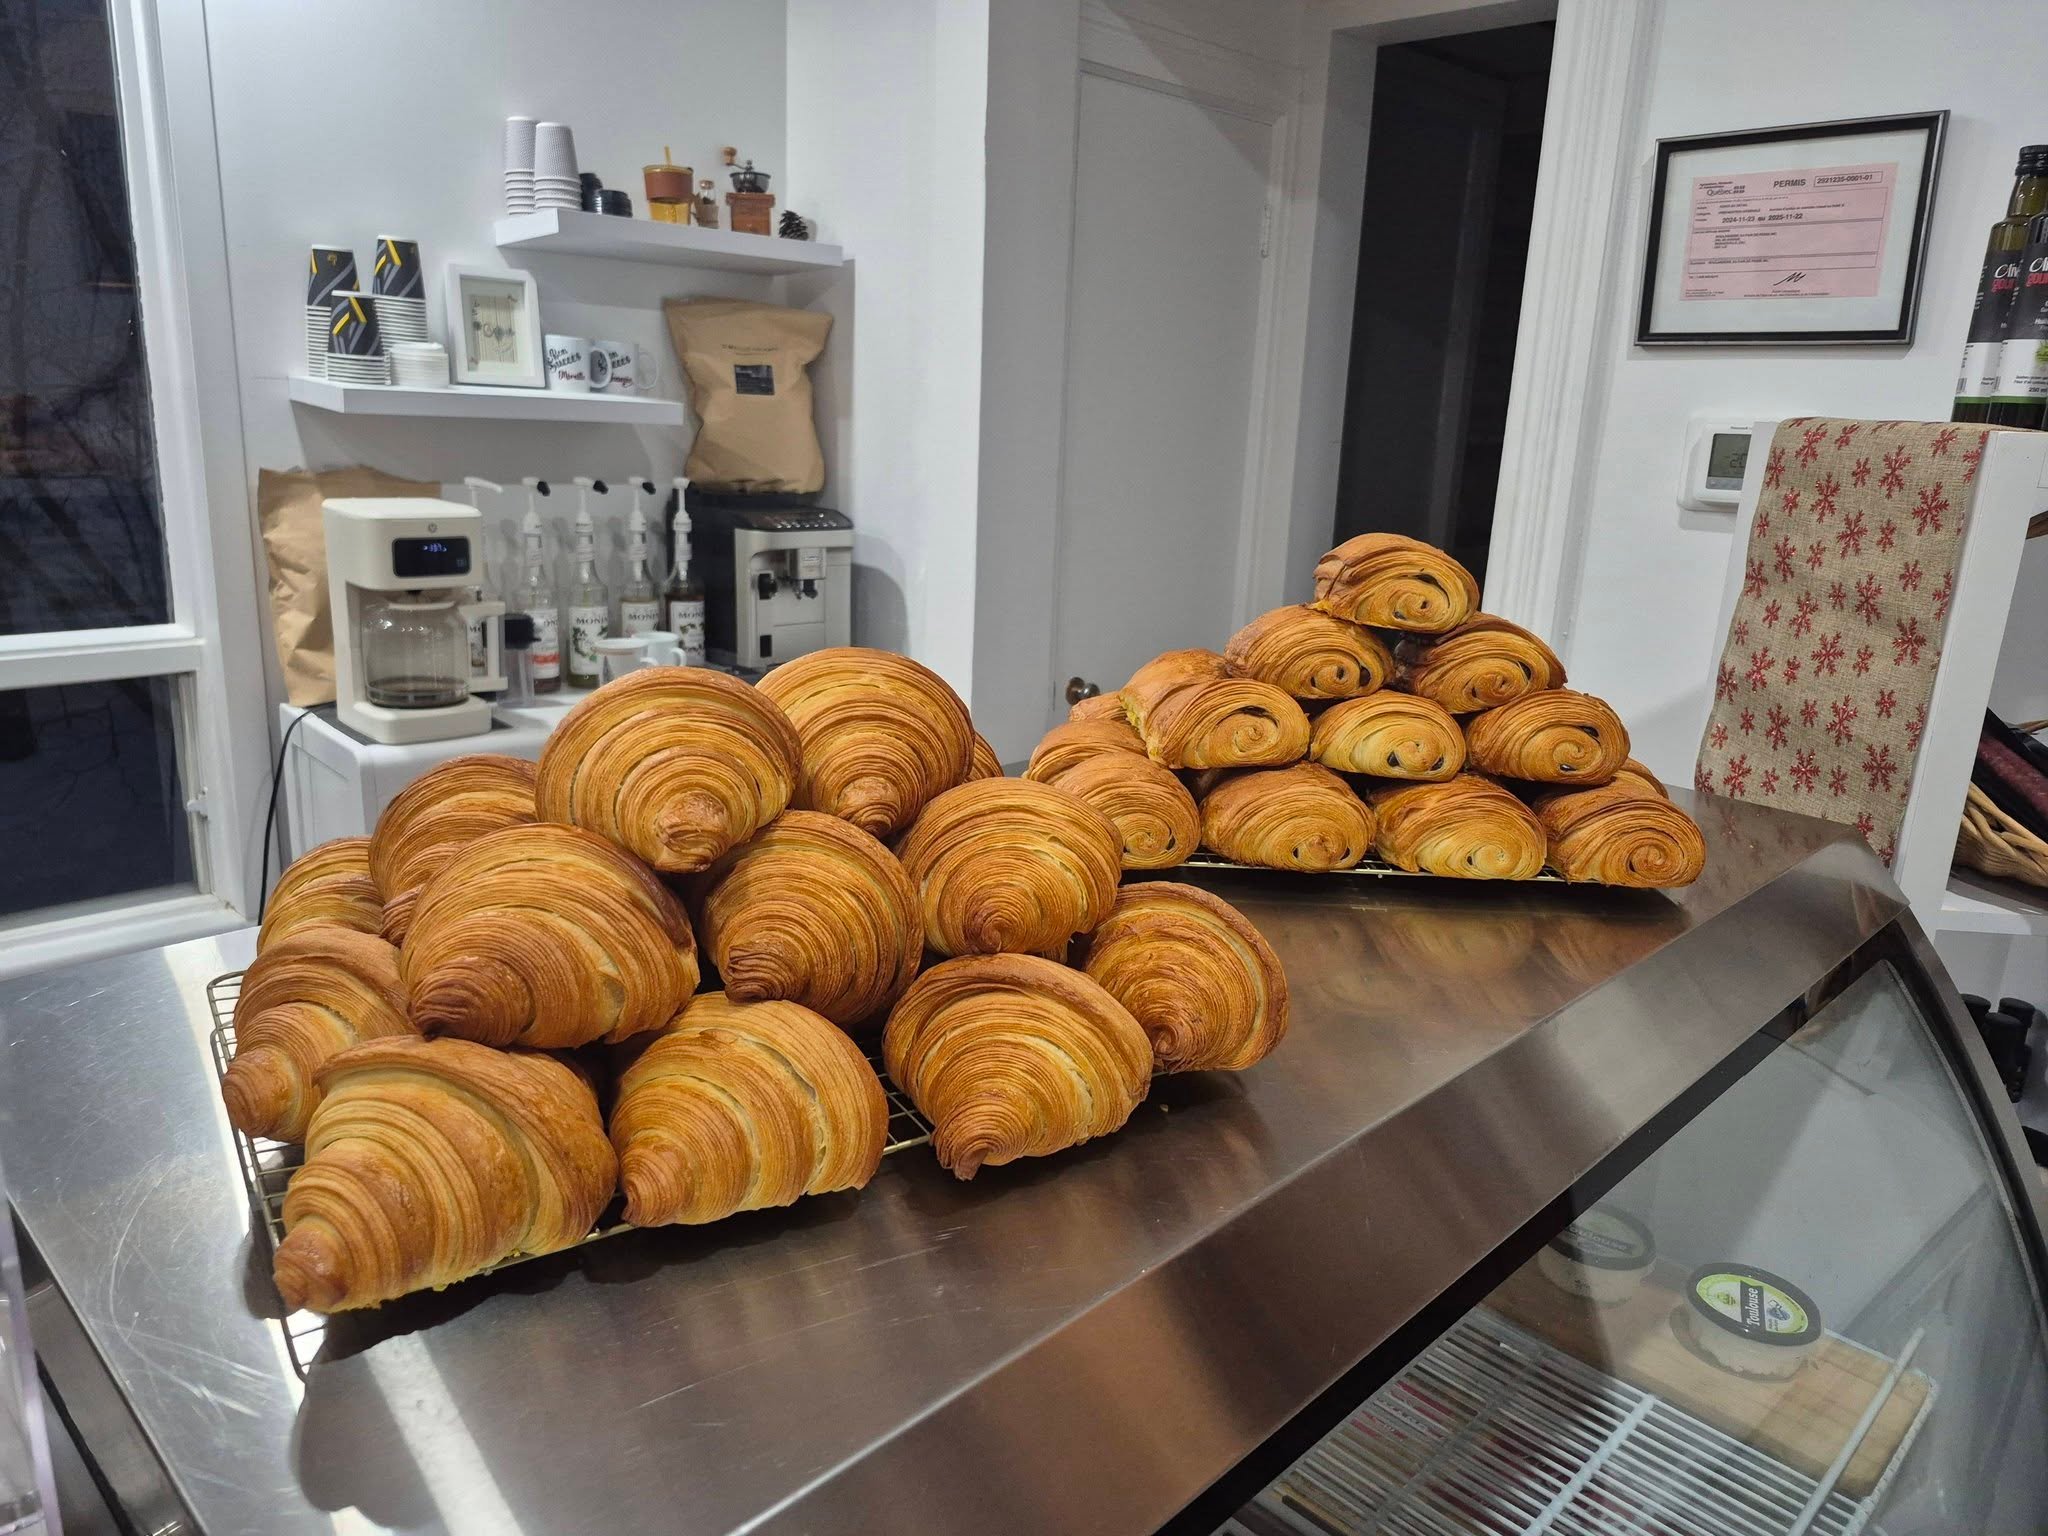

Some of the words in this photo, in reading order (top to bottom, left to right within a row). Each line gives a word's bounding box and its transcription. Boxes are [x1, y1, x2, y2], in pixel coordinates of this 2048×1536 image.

[1773, 179, 1807, 188] PERMIS
[1767, 213, 1803, 221] 2025-11-22
[1745, 1287, 1761, 1327] Toulouse
